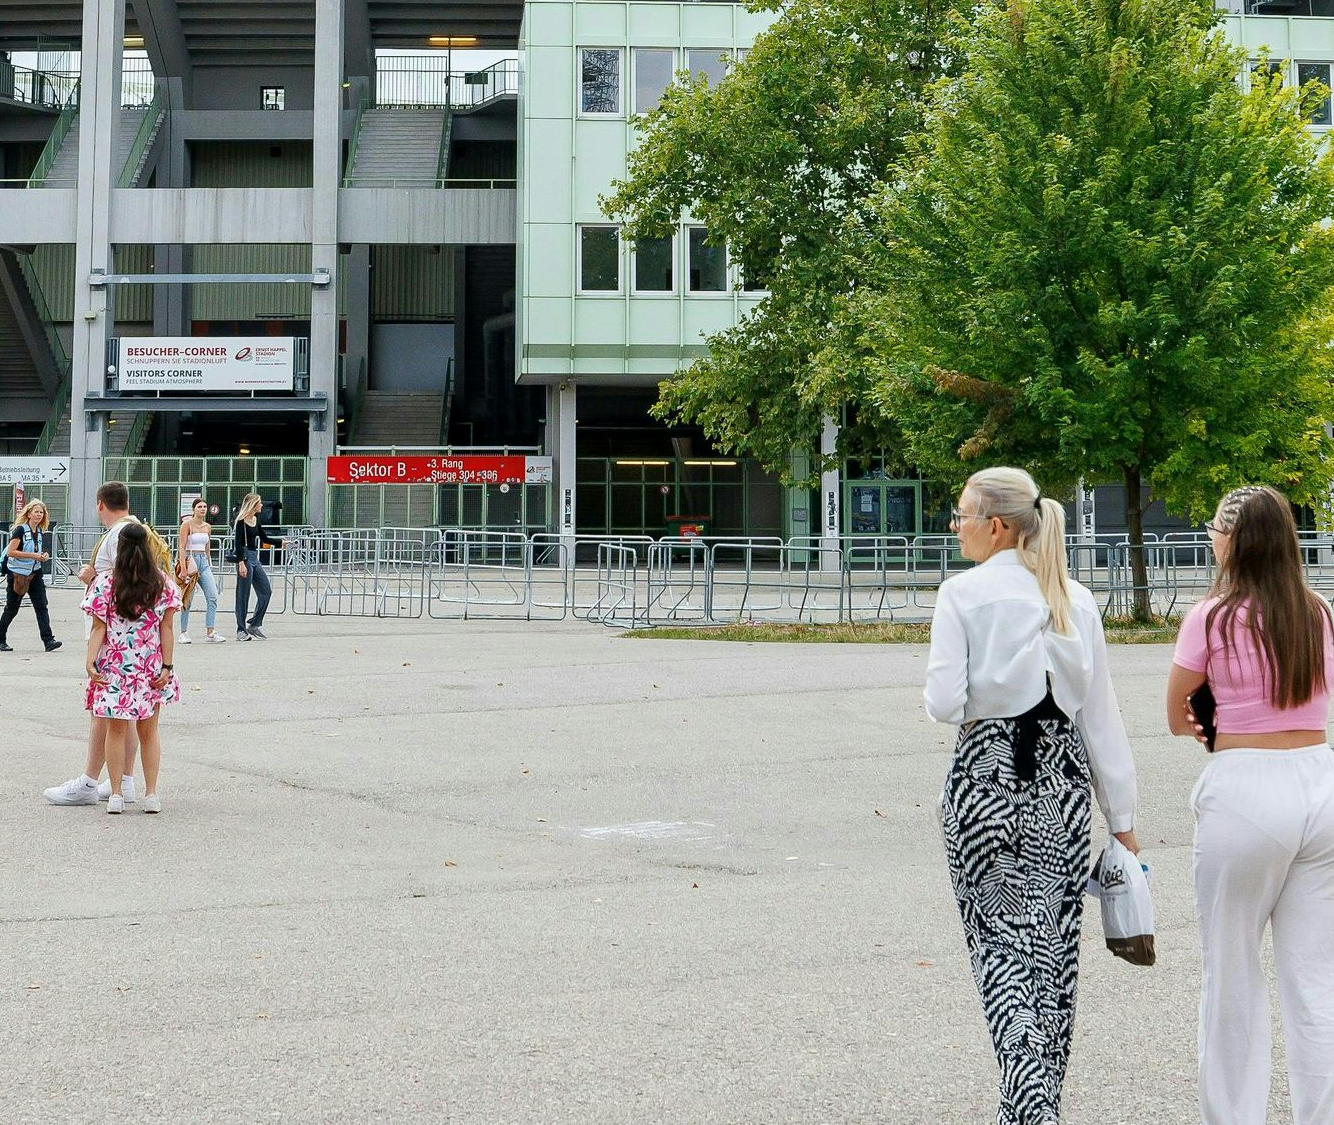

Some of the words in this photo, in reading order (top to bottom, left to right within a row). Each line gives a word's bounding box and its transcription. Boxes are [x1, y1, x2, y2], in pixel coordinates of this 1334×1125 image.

[127, 347, 227, 356] BESUCHER-CORNER
[126, 370, 165, 378] VISITORS
[167, 370, 203, 378] CORNER
[349, 461, 393, 477] Sektor
[397, 462, 406, 477] B
[441, 459, 464, 469] Rang
[431, 470, 457, 481] Stiege
[459, 470, 475, 480] 304
